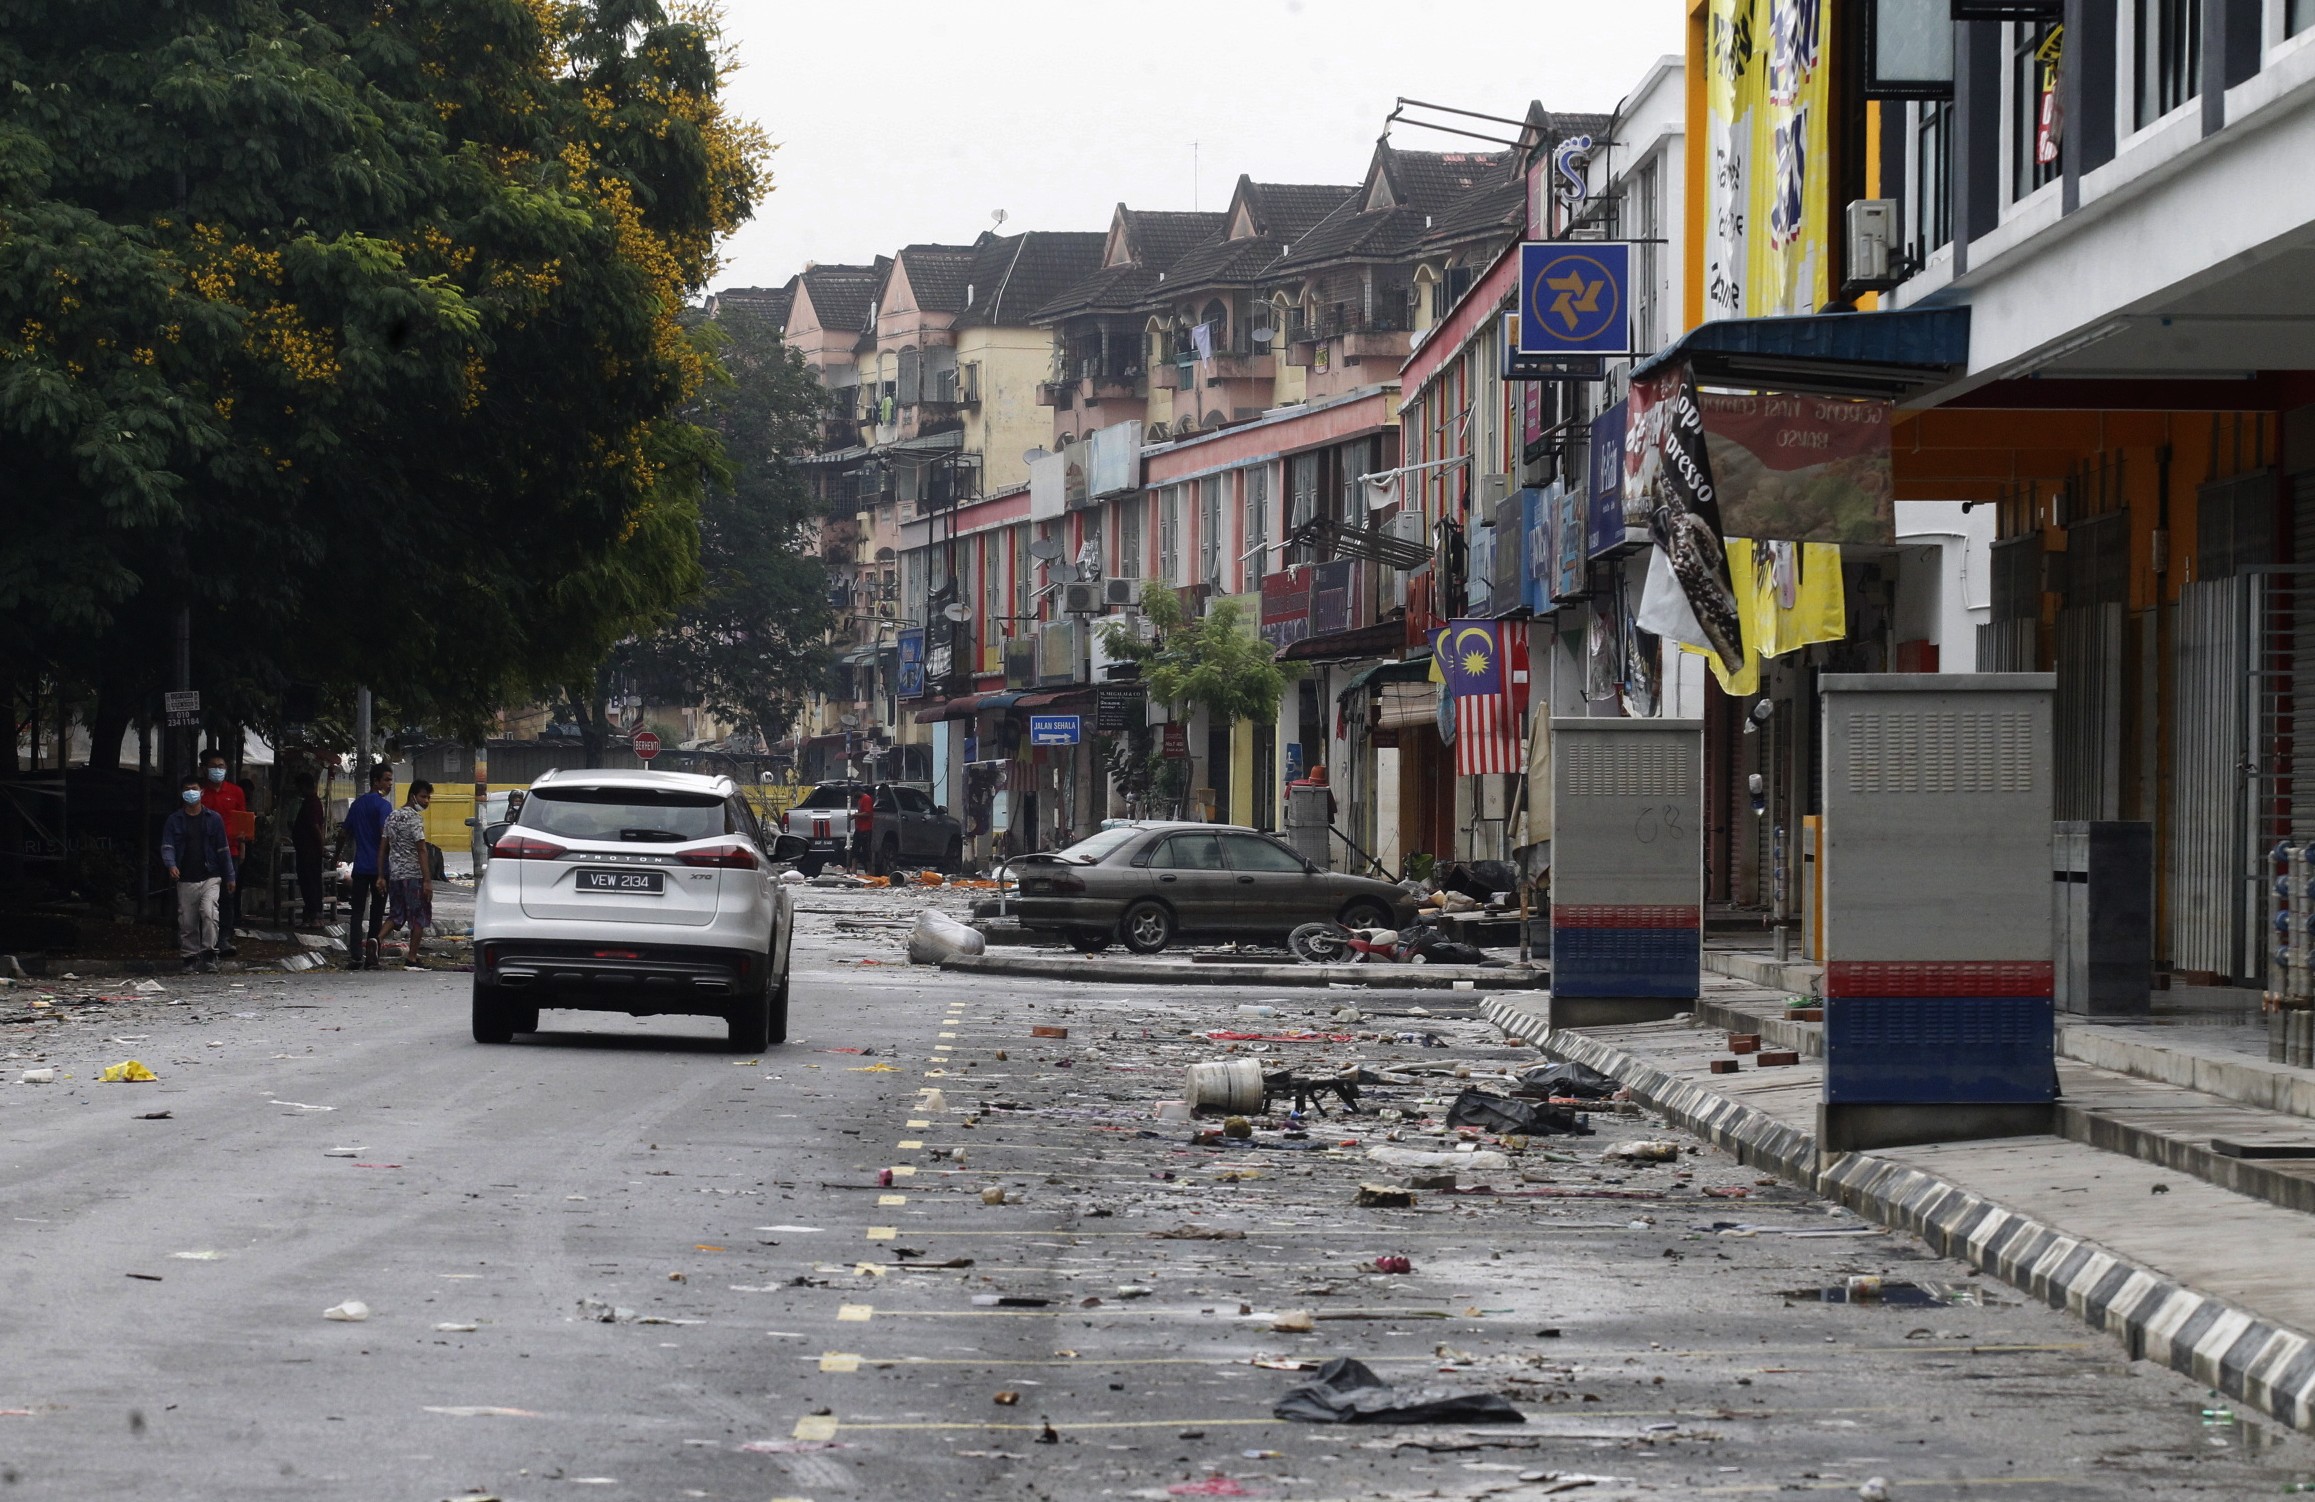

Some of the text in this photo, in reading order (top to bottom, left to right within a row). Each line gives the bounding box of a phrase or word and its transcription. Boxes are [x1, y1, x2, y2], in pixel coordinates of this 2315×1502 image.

[176, 711, 190, 719] 010
[168, 717, 200, 727] 234 1184
[1034, 721, 1076, 731] JALAN SEHALA
[635, 740, 659, 751] BERHENTI
[579, 854, 662, 863] PROTON
[591, 873, 650, 888] VEW 2134
[689, 873, 713, 881] X70
